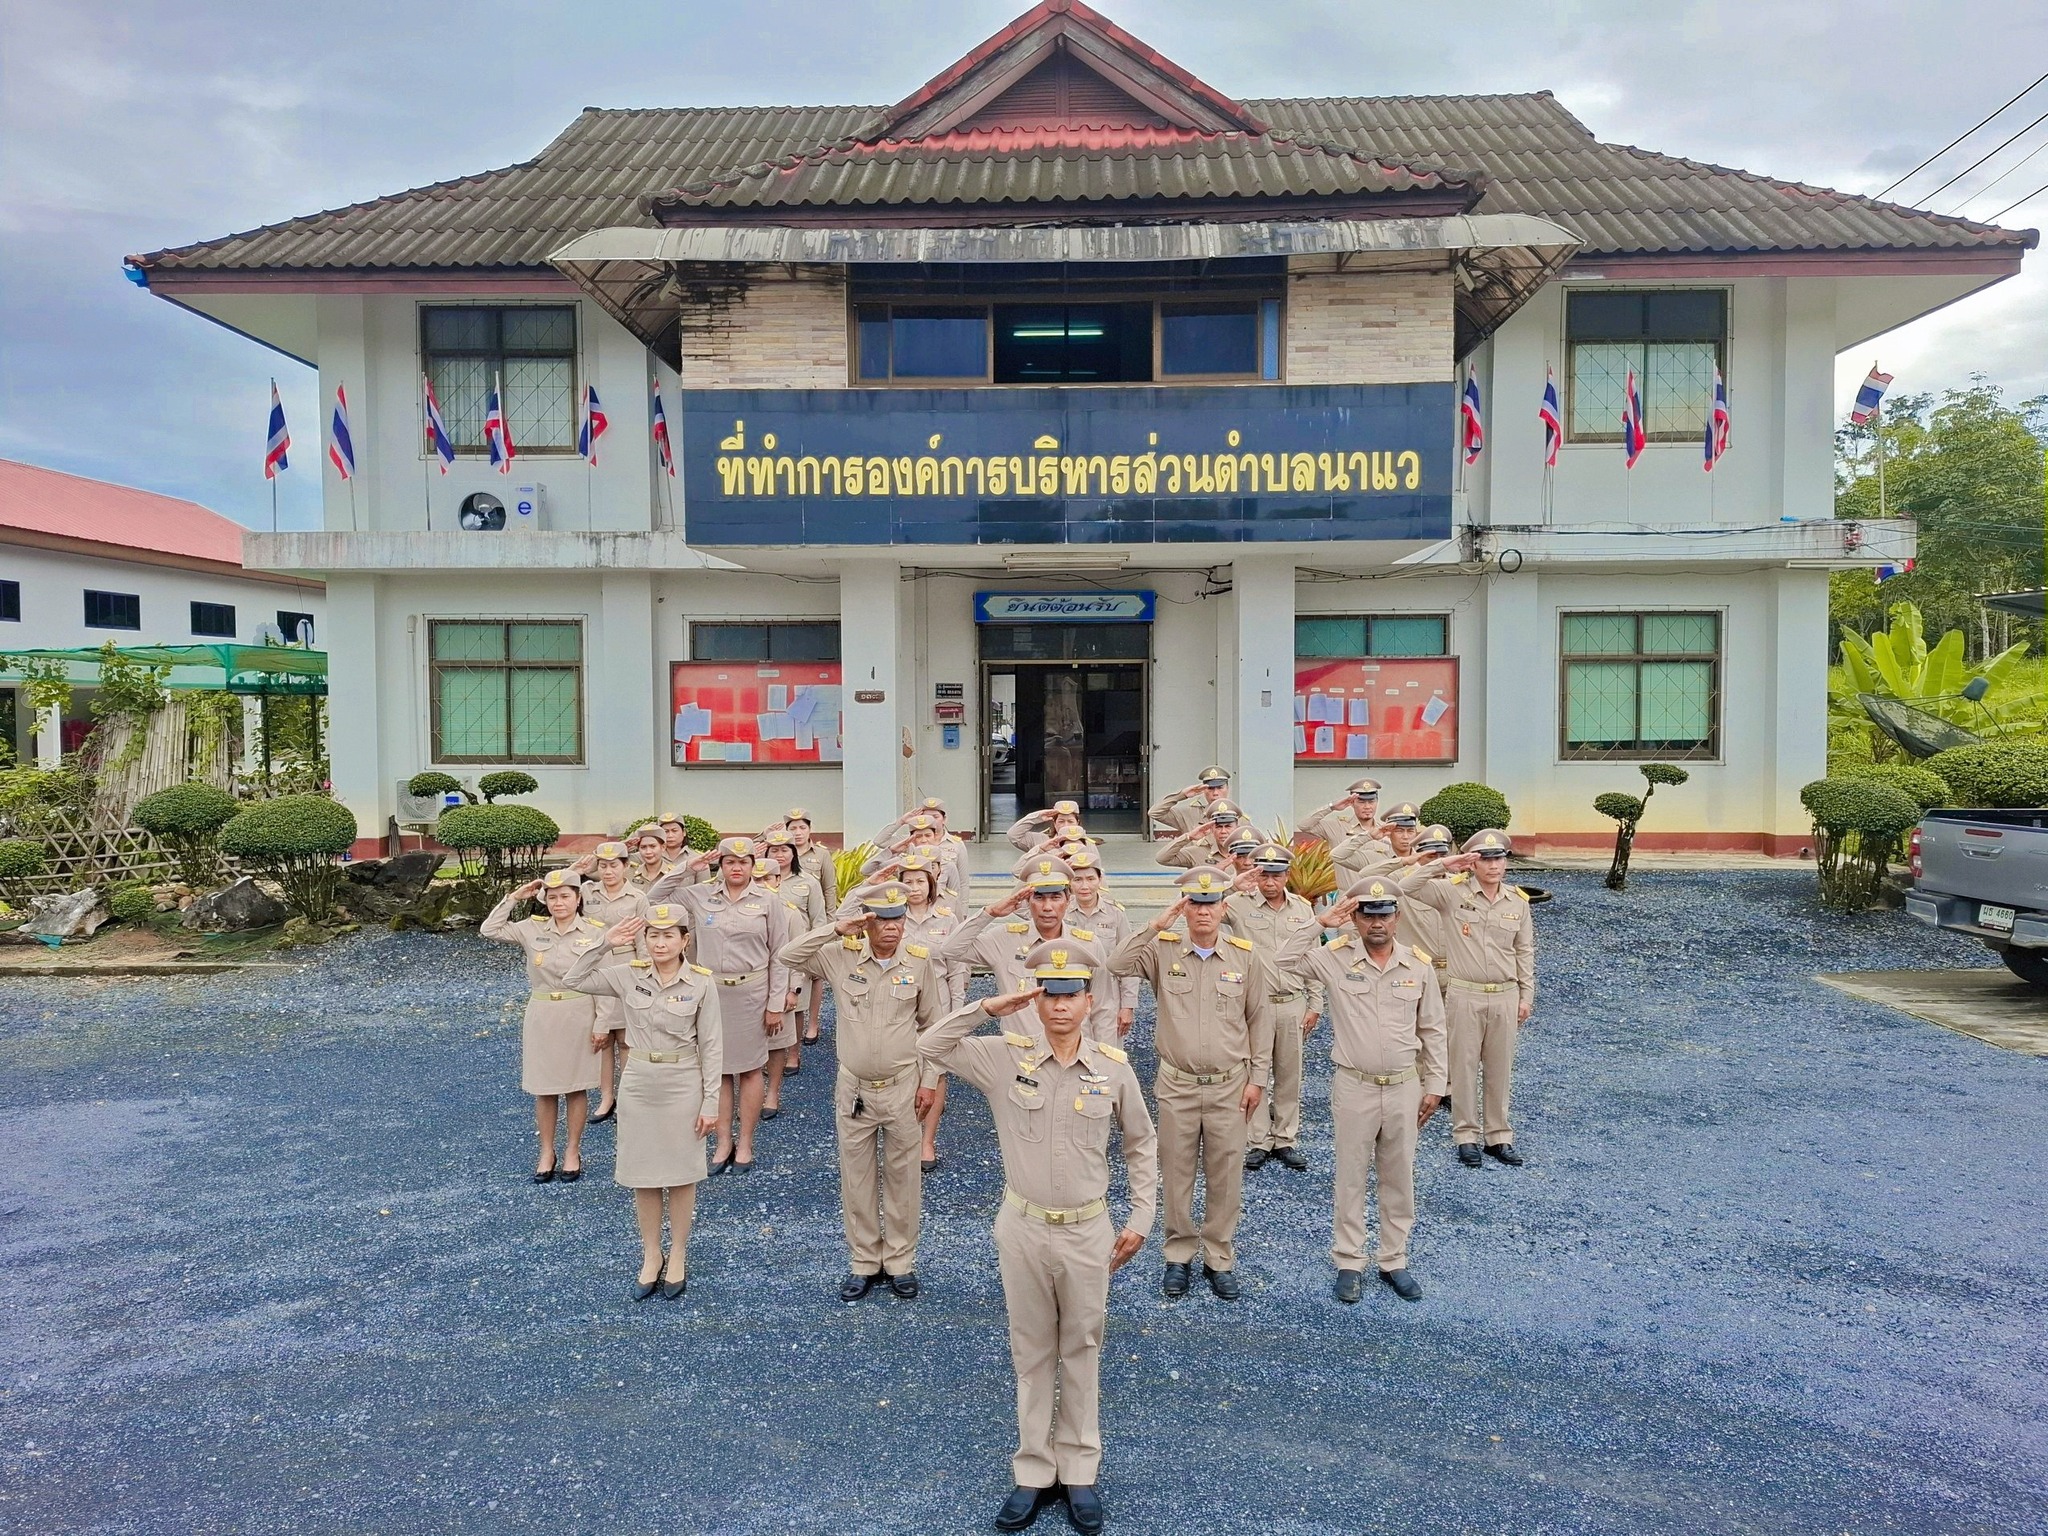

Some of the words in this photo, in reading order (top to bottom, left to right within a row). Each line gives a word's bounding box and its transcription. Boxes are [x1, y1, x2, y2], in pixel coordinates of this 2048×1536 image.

[717, 420, 1420, 496] ที่ทำการองค์การบริหารส่วนตำบลนาแว
[1006, 596, 1128, 614] ยินดีต้อนรับ
